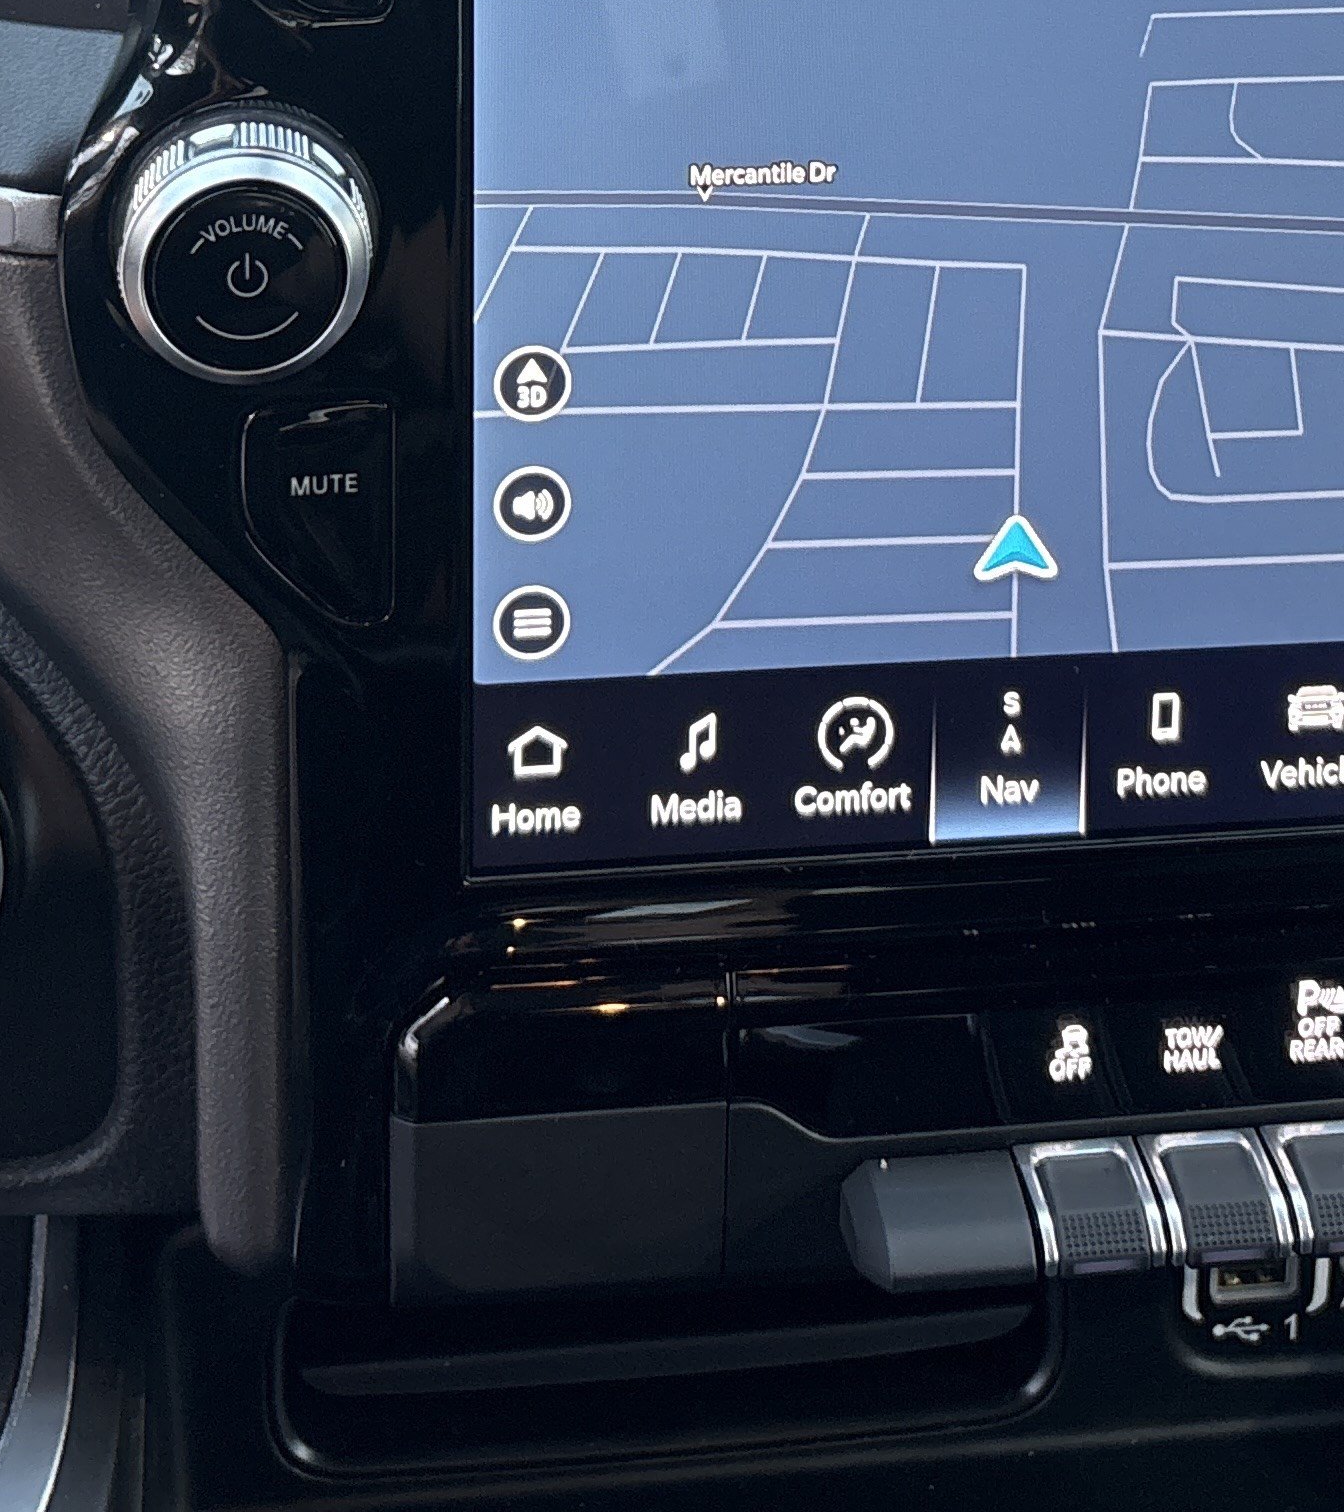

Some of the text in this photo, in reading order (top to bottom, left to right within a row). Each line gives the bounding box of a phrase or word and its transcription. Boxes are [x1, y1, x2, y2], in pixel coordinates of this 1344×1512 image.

[689, 162, 837, 187] Mercantile Dr
[201, 214, 290, 243] VOLUME
[517, 385, 547, 408] 3D
[290, 473, 359, 496] MUTE
[980, 775, 1040, 806] Nav
[1116, 766, 1208, 801] Phone
[650, 791, 743, 826] Media
[794, 781, 913, 816] Comfort
[490, 803, 581, 836] Home
[1165, 1025, 1224, 1050] TOW/
[1297, 1015, 1342, 1037] OFF
[1049, 1056, 1093, 1082] OFF
[1163, 1047, 1222, 1074] HAUL
[1283, 1314, 1300, 1341] 1
